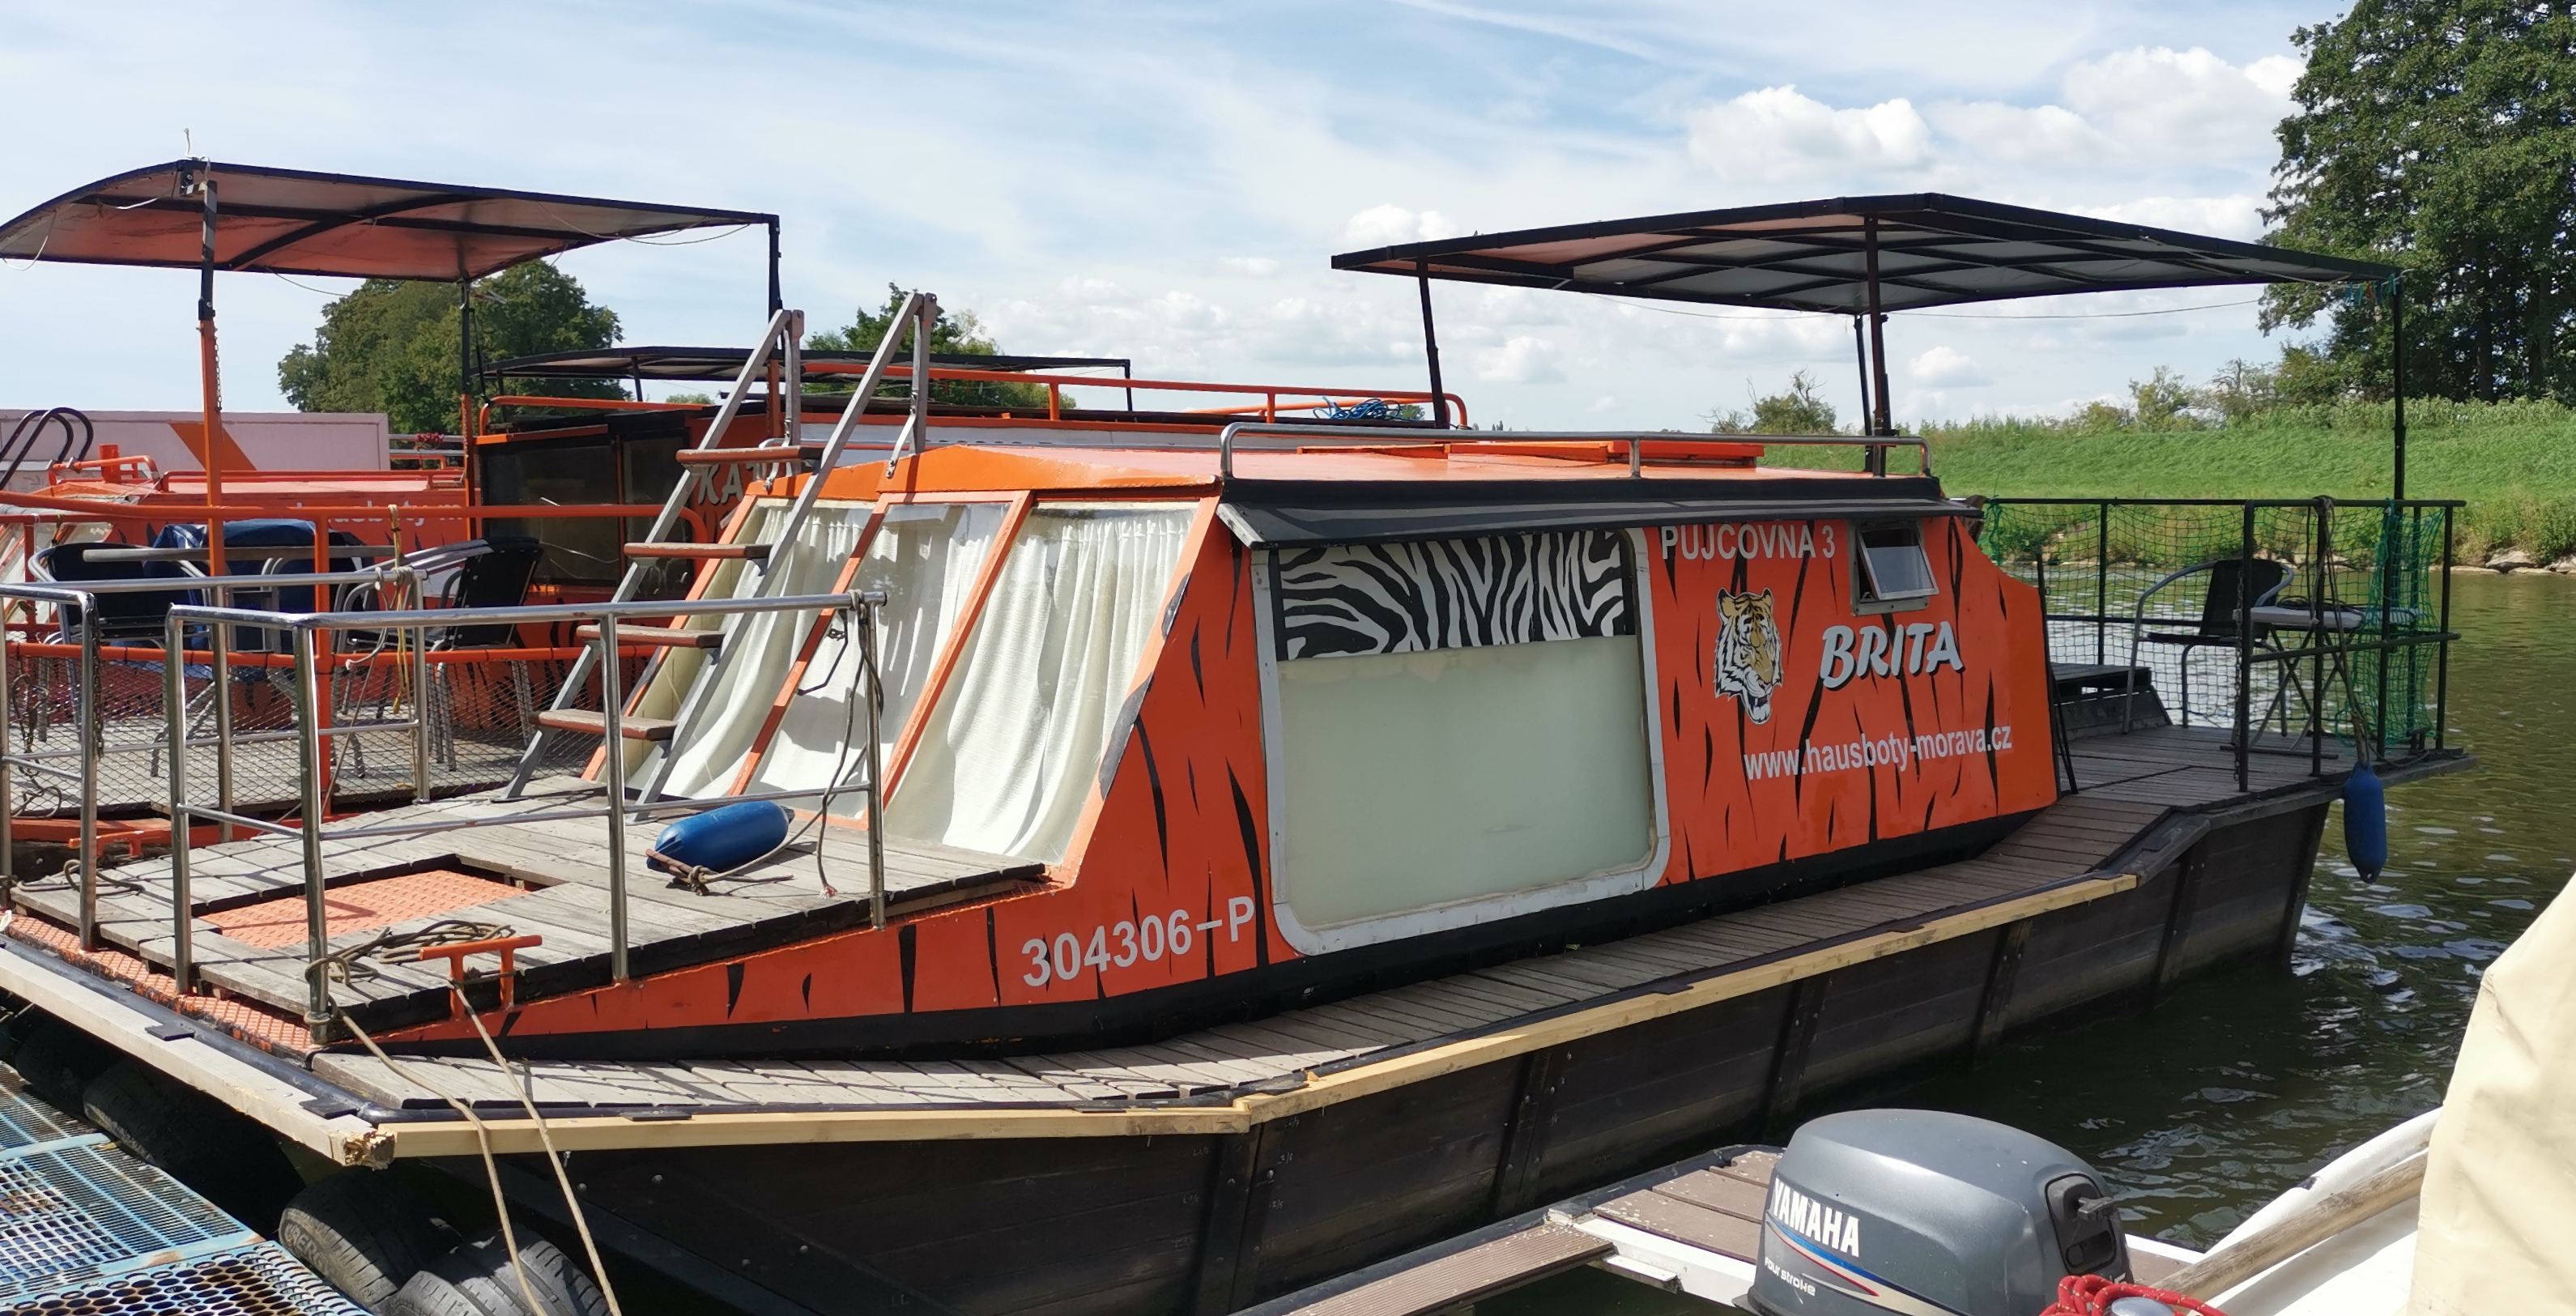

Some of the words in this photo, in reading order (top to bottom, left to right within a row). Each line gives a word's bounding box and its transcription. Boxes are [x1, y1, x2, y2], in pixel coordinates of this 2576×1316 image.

[1661, 524, 1816, 560] PUJCOVNA
[1822, 525, 1836, 559] 3
[1820, 620, 1965, 691] BRITA
[1744, 726, 2012, 780] www.hausboty-morava.cz
[1021, 896, 1255, 986] 304306-P
[1773, 1177, 1859, 1258] YAMAHA
